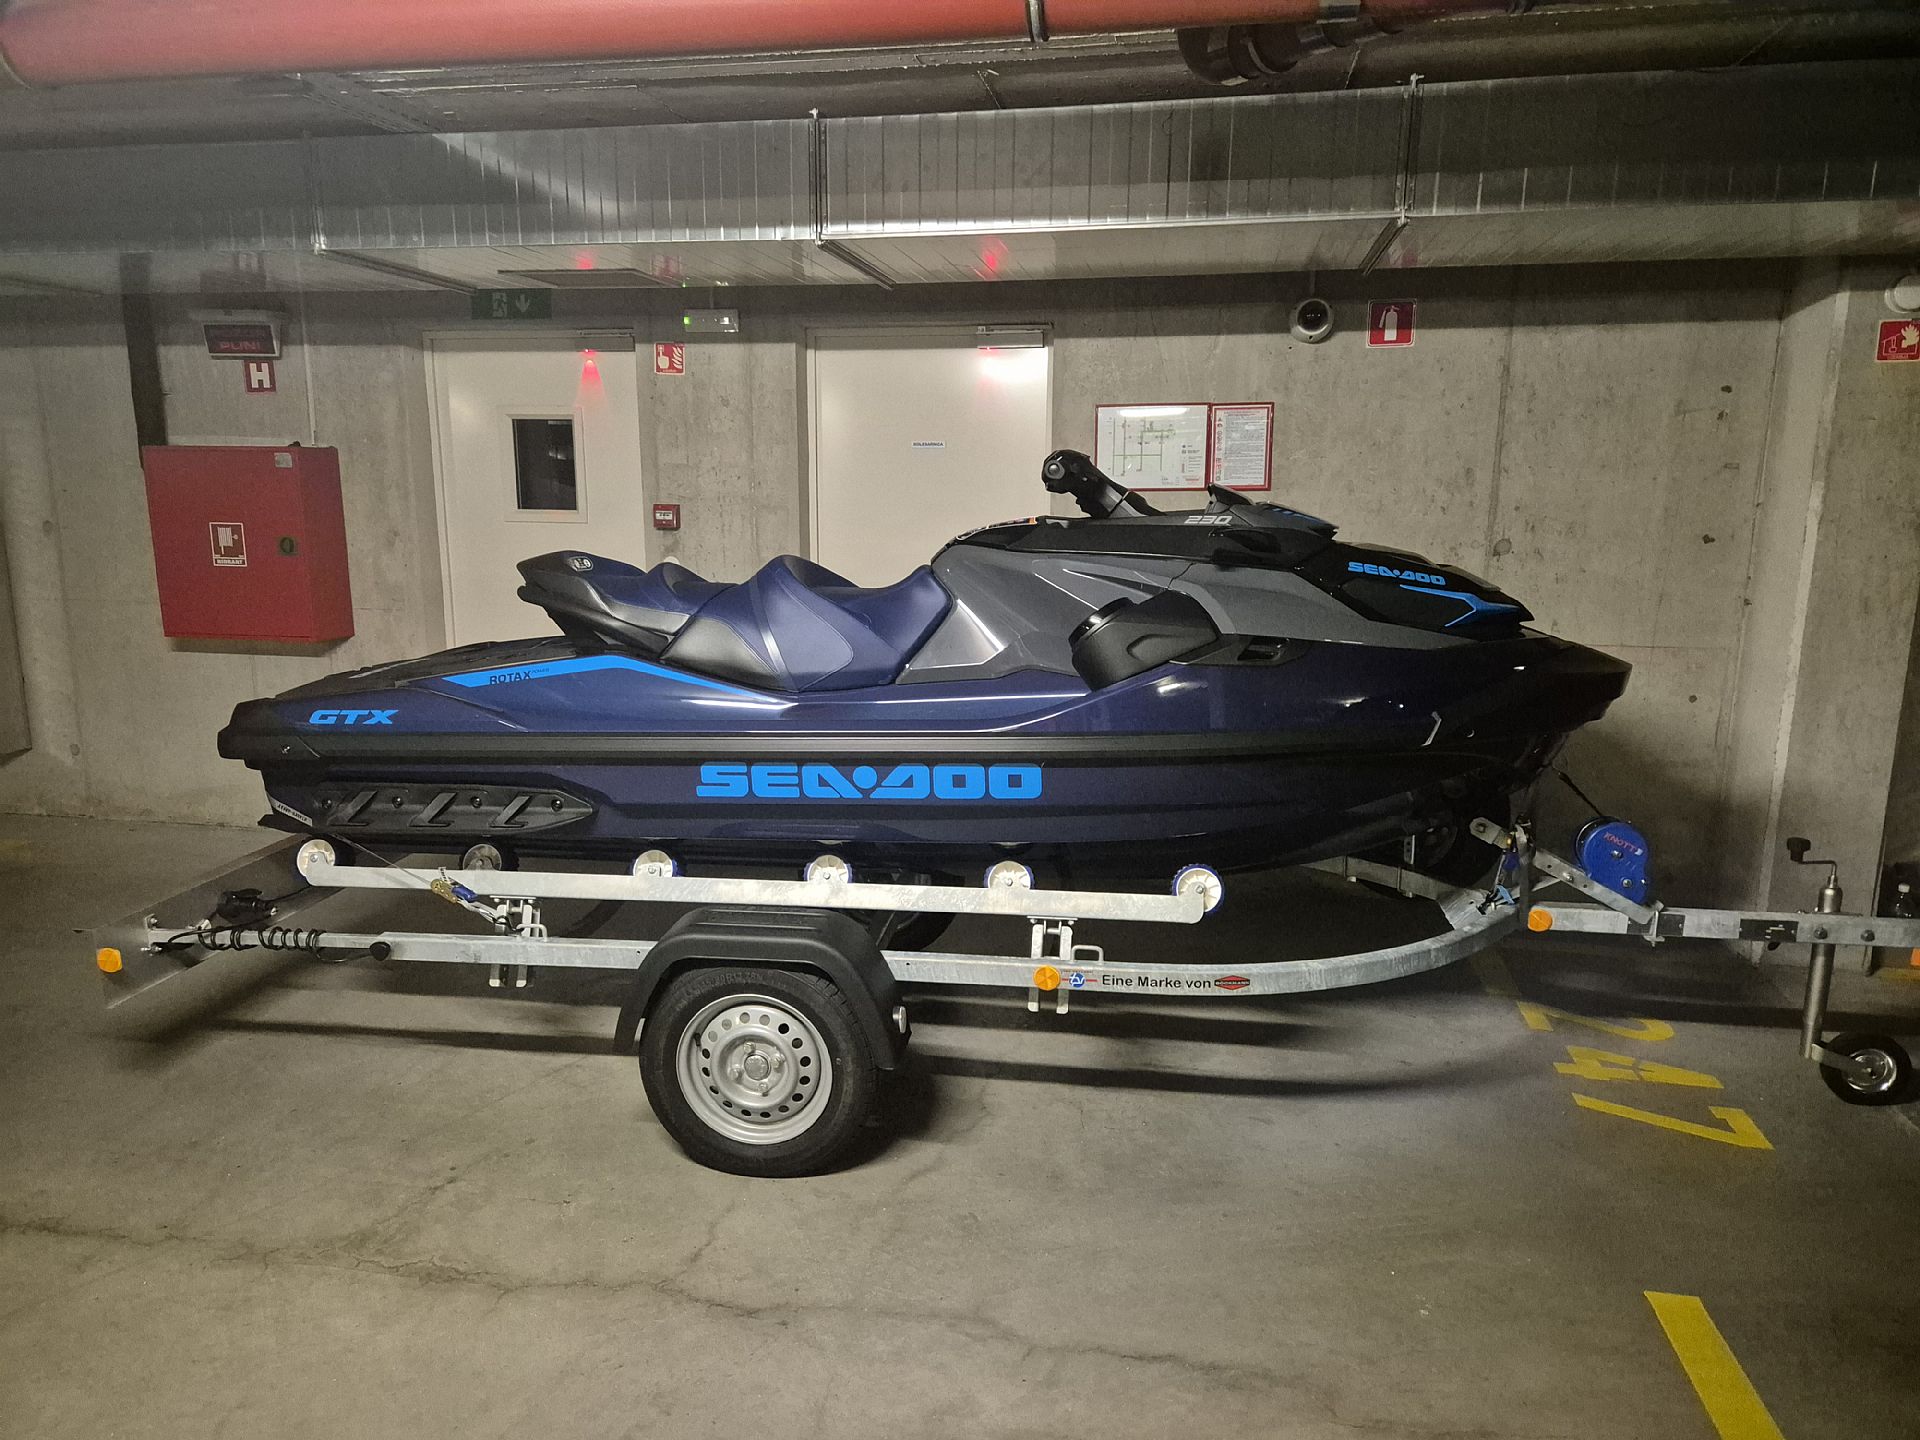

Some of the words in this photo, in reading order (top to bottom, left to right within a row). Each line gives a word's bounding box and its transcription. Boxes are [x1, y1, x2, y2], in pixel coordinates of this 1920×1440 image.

[249, 363, 271, 388] H
[1184, 515, 1233, 525] 230
[490, 671, 531, 685] ROTAX
[309, 709, 399, 725] GTX
[1603, 831, 1637, 853] KNOTT
[1102, 974, 1133, 986] Eine
[1138, 976, 1182, 989] Marke
[1186, 980, 1212, 989] von
